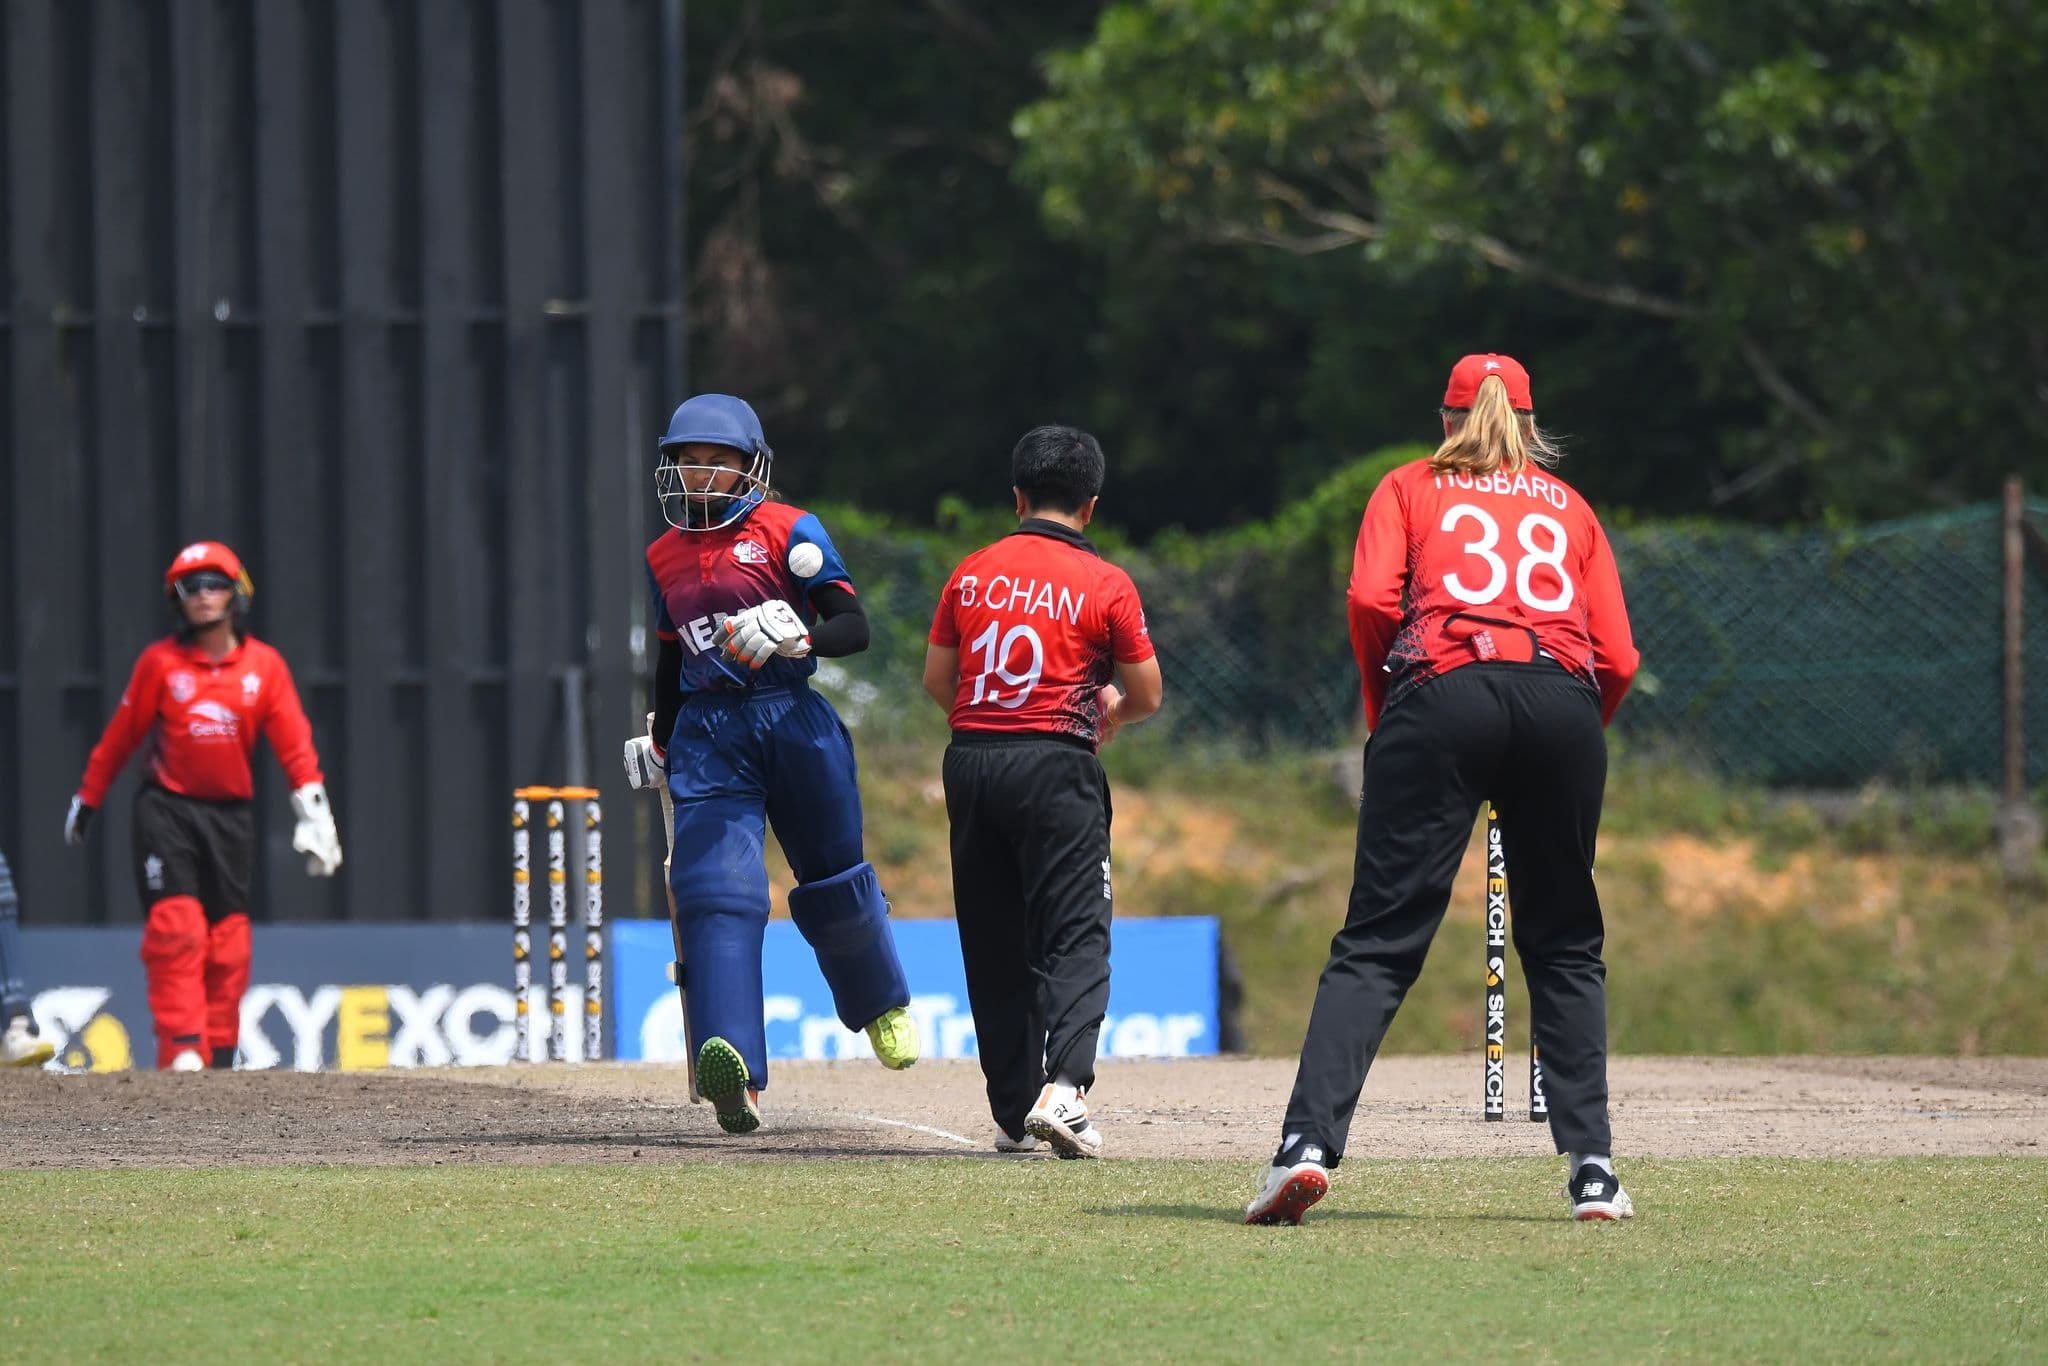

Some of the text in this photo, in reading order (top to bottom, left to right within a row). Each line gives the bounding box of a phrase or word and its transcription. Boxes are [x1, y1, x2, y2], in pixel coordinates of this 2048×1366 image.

[959, 575, 1085, 626] B.CHAN
[1440, 503, 1574, 612] 38
[970, 620, 1044, 709] 19
[1488, 827, 1505, 946] SKYEXCH
[237, 983, 585, 1072] KYEXCH
[1486, 994, 1504, 1114] SKYEXCH
